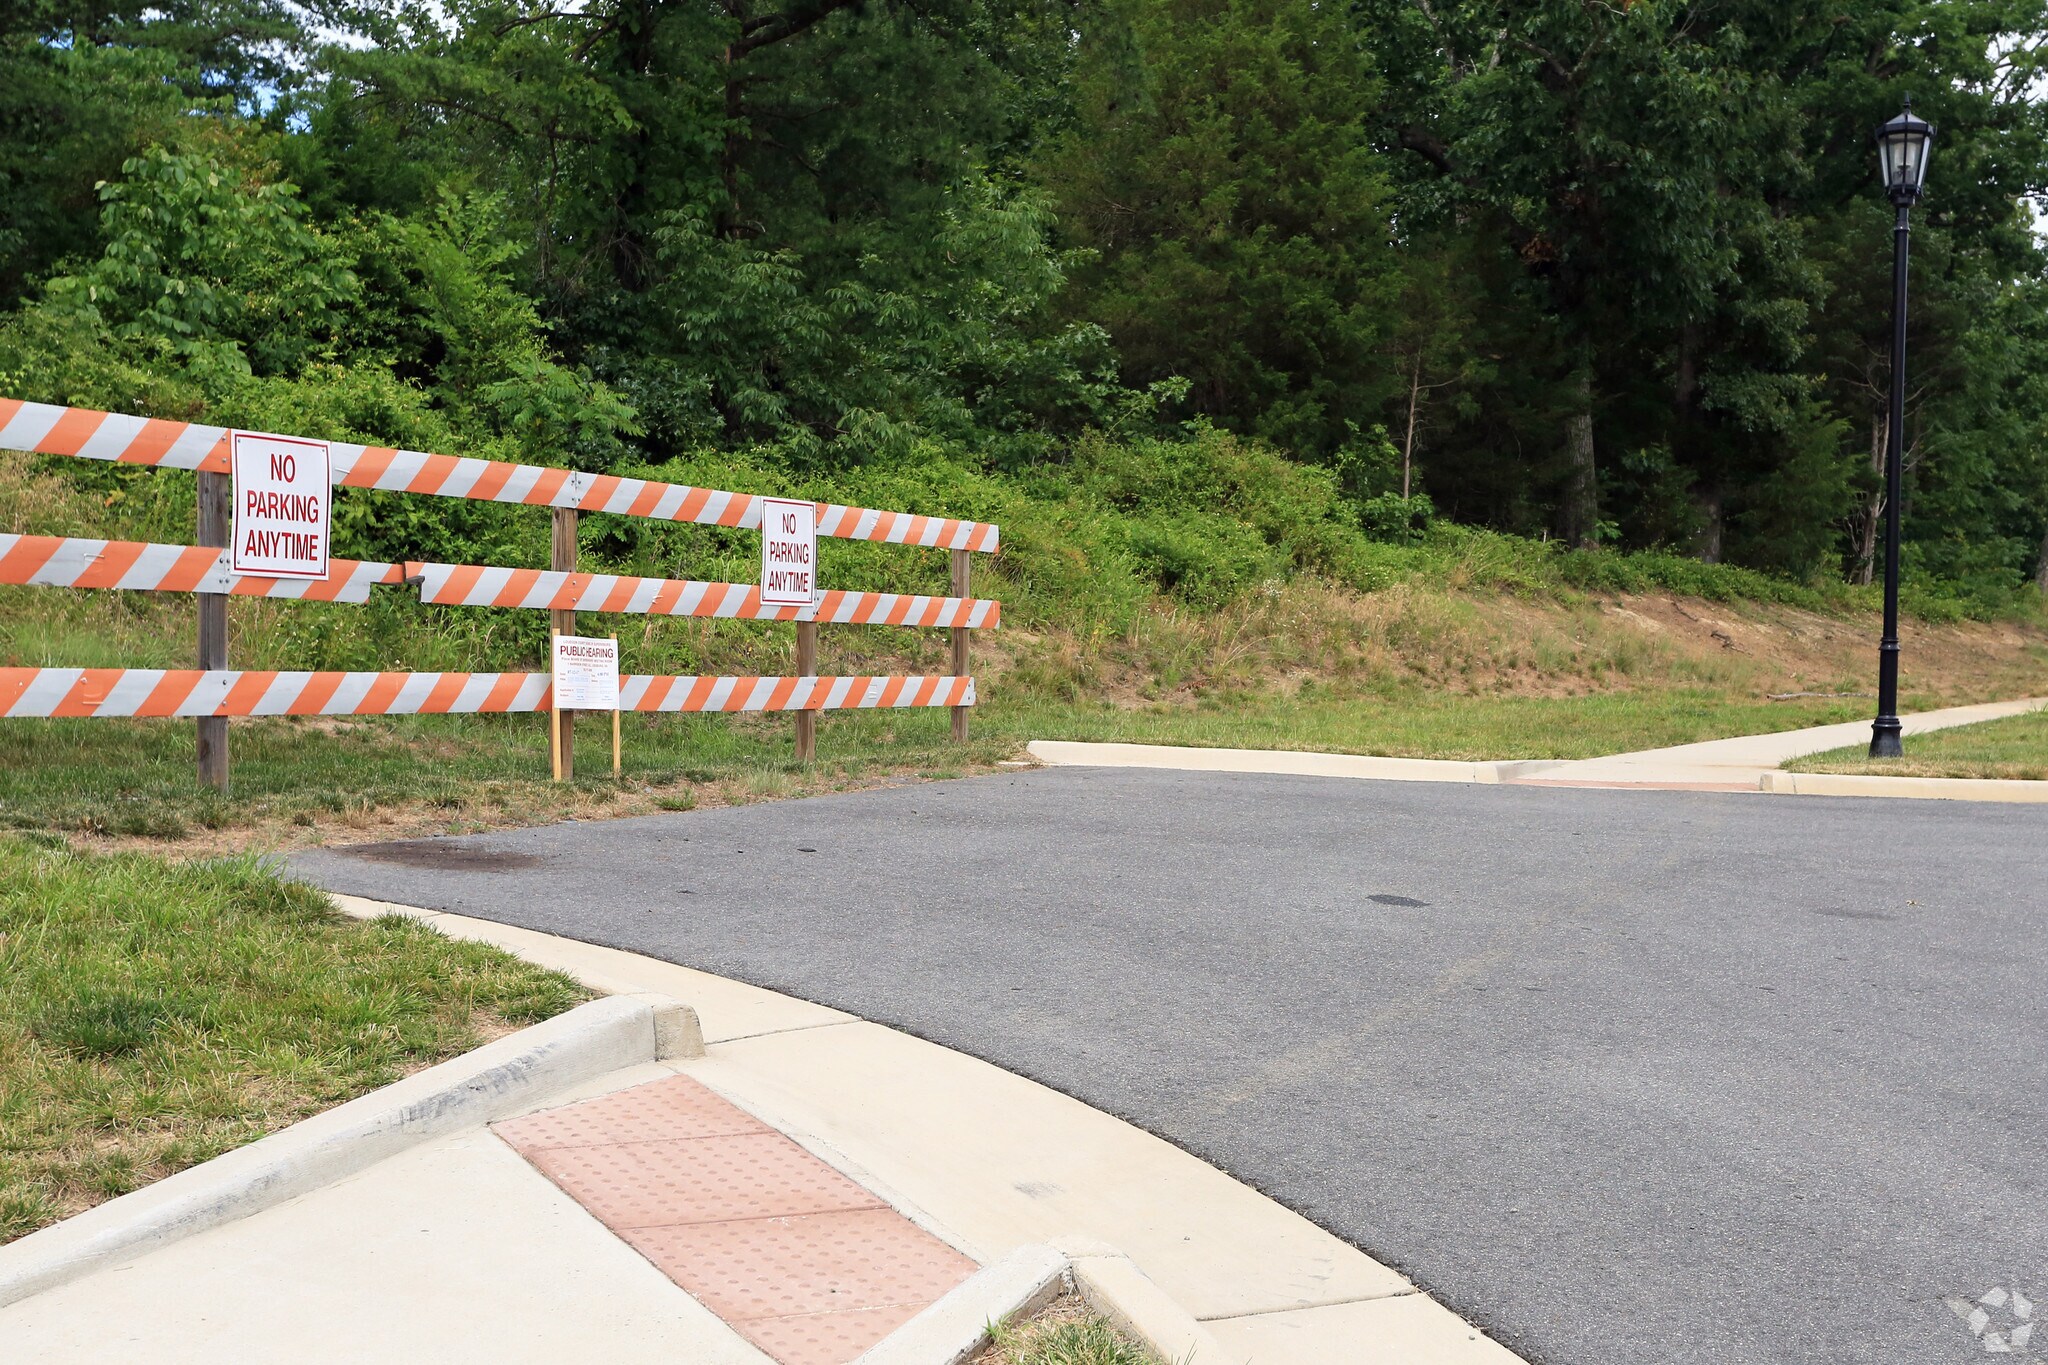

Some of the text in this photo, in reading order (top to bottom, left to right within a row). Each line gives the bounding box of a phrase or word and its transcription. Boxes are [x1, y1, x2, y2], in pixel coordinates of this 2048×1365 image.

[270, 453, 296, 483] NO
[247, 490, 319, 524] PARKING
[782, 513, 797, 535] NO
[245, 529, 319, 562] ANYTIME
[769, 541, 810, 565] PARKING
[768, 571, 810, 593] ANYTIME
[560, 645, 614, 659] PUBLIC HEARING
